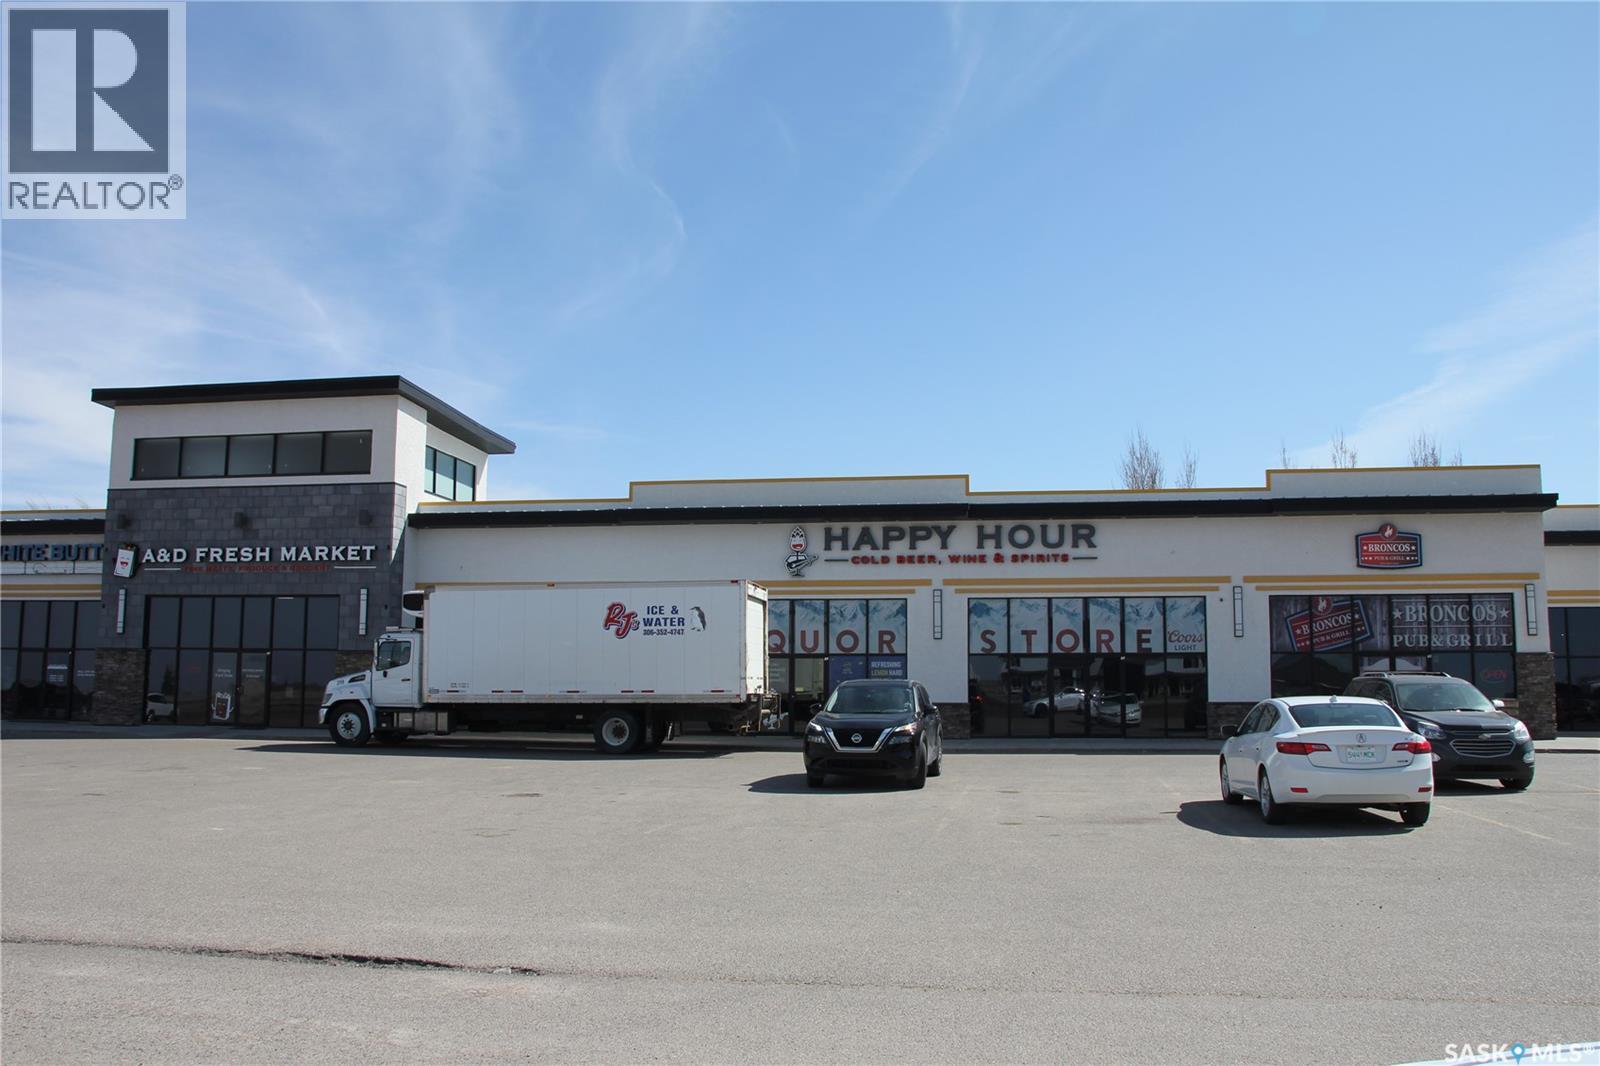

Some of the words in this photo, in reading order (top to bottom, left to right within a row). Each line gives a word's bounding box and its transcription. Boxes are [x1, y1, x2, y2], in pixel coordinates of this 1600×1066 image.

[823, 523, 958, 551] HAPPY
[976, 522, 1097, 549] HOUR
[141, 548, 188, 563] A&D
[195, 546, 271, 562] FRESH
[280, 545, 377, 561] MARKET
[1368, 543, 1411, 553] BRONCOS
[851, 555, 891, 566] COLD
[895, 554, 943, 566] BEER,
[948, 553, 988, 564] WINE
[993, 552, 1005, 564] &
[1010, 552, 1070, 564] SPIRITS
[646, 605, 665, 616] ICE
[670, 605, 679, 616] &
[1403, 603, 1498, 624] BRONCOS
[642, 617, 685, 627] WATER
[1301, 612, 1352, 635] BRONCOS
[643, 629, 685, 637] 306-352-4747
[1167, 630, 1203, 644] Coors
[979, 627, 1154, 655] STORE
